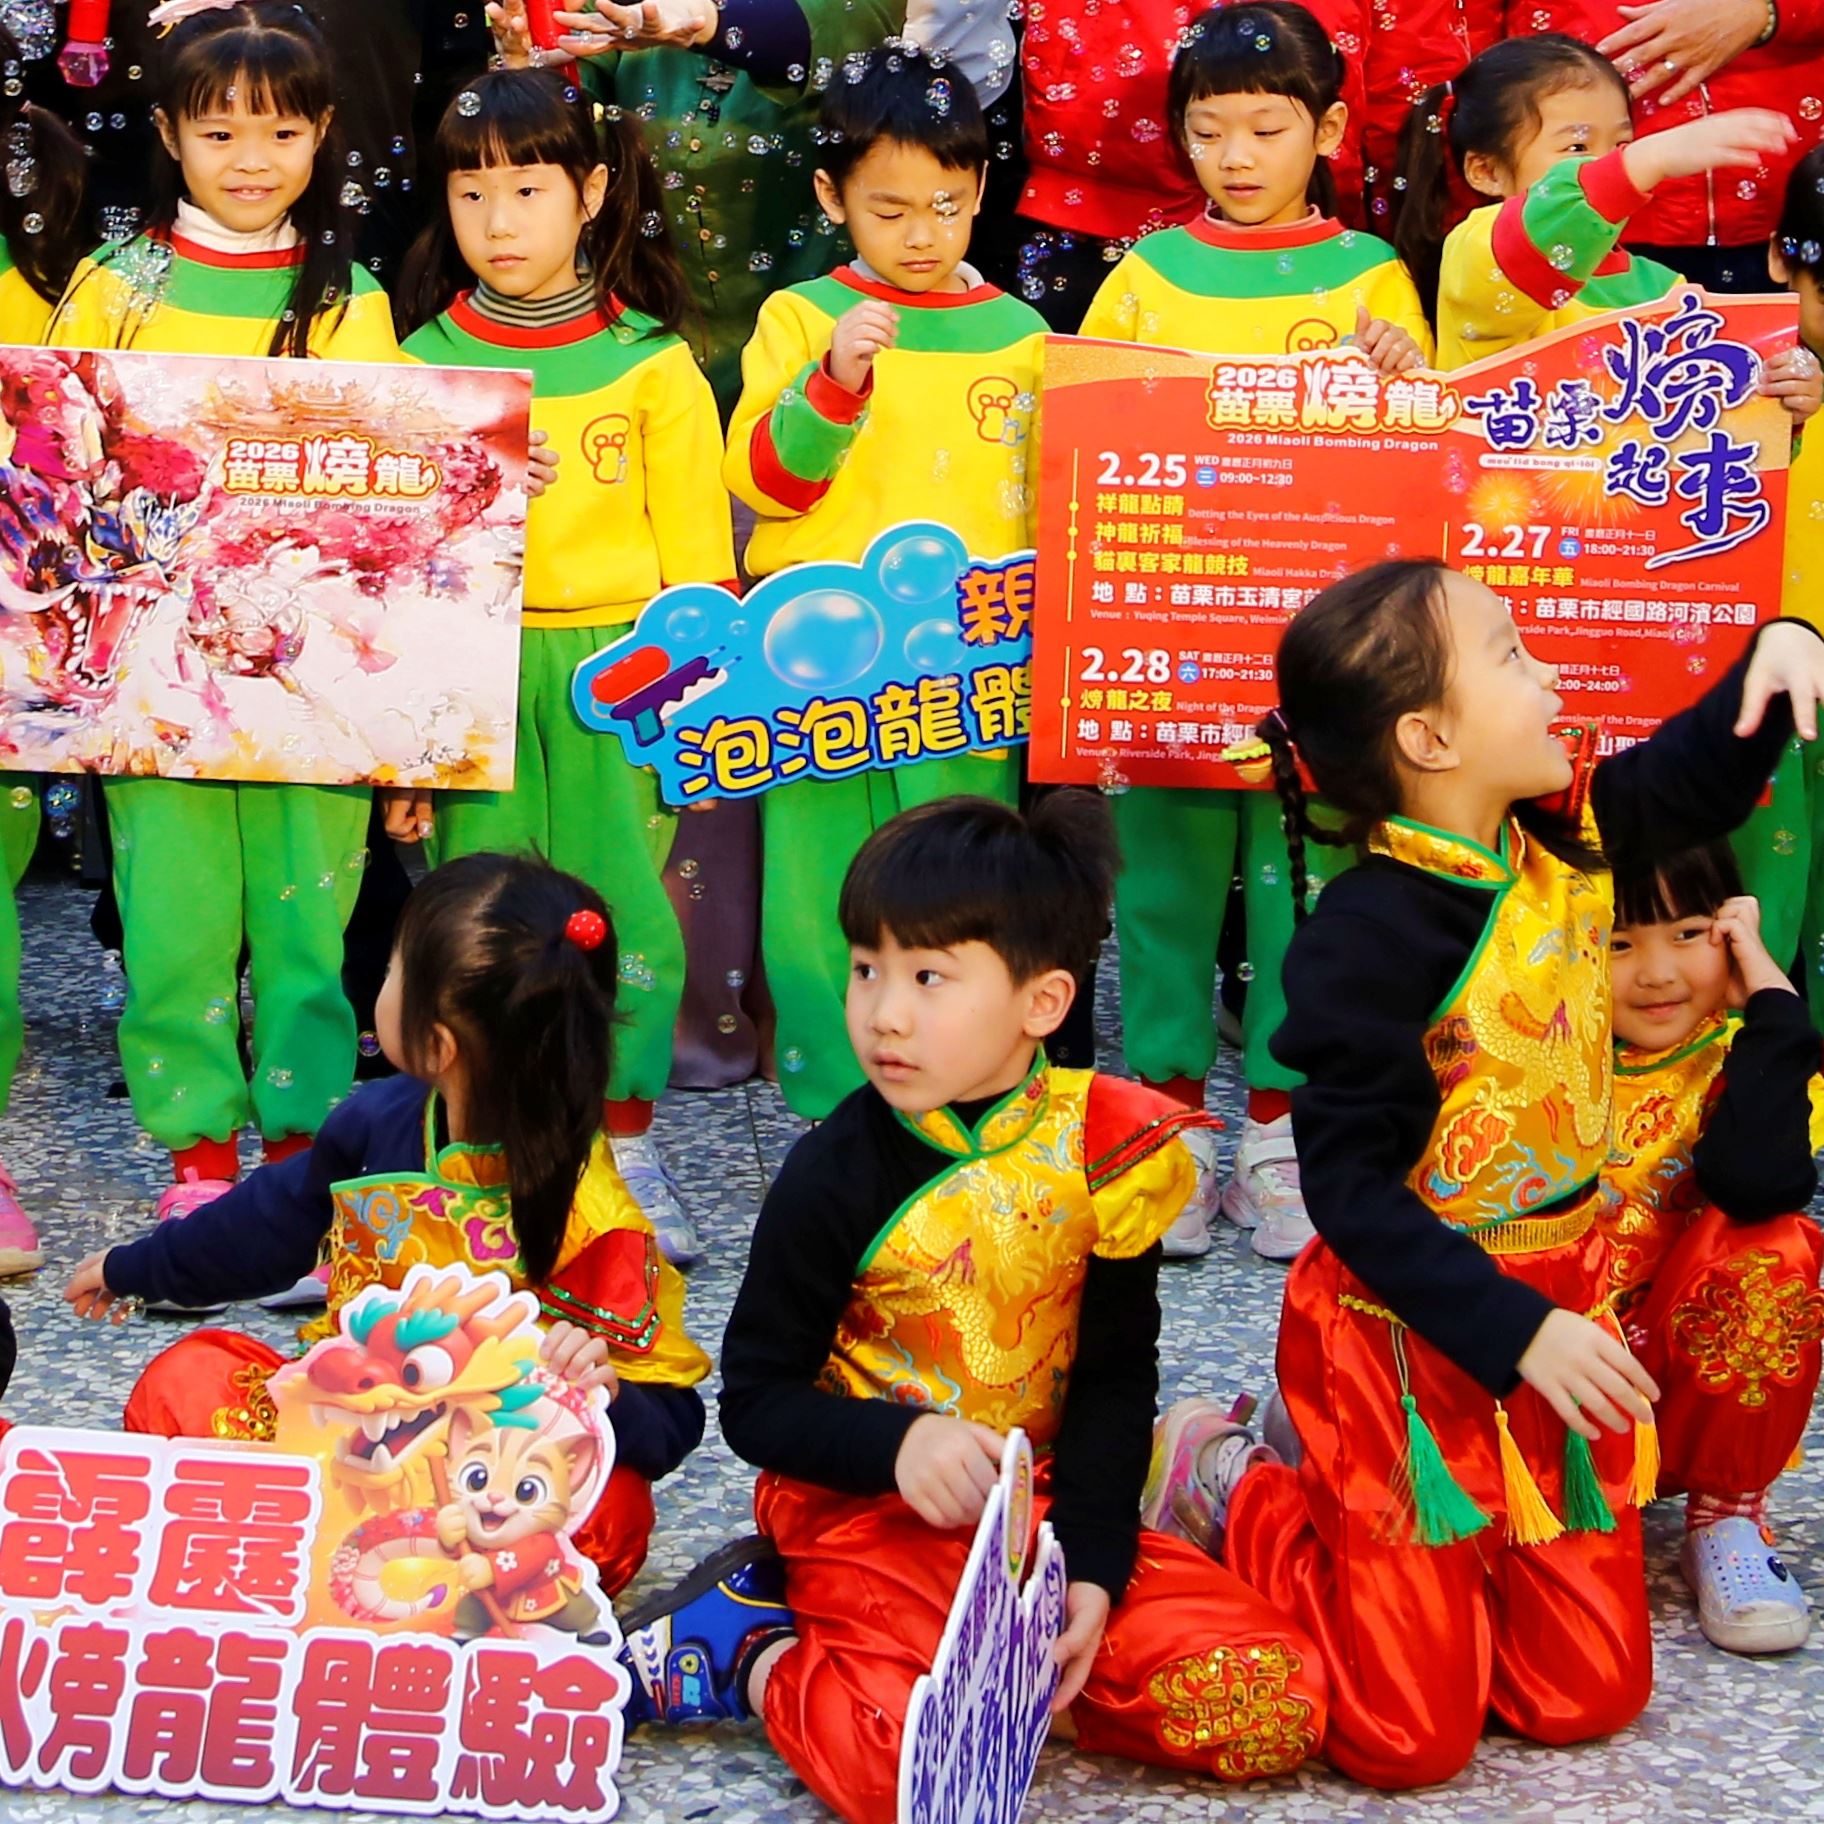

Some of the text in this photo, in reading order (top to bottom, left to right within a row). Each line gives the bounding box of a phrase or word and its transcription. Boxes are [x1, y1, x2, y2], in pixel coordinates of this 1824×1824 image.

[1216, 365, 1298, 388] 2026
[229, 440, 300, 460] 2026
[1227, 432, 1438, 453] 2026 Miaoli Bombing Dragon
[1194, 454, 1220, 466] WED
[1097, 451, 1187, 487] 2.25
[240, 496, 269, 508] 2026
[374, 502, 421, 515] Dragon
[1096, 492, 1185, 517] 祥龍點睛
[1188, 507, 1225, 522] Dotting
[1228, 509, 1244, 521] the
[1247, 510, 1270, 524] Eyes
[1272, 510, 1282, 522] of
[1283, 511, 1300, 523] the
[1359, 514, 1395, 527] Dragon
[1095, 521, 1185, 546] 神龍祈福
[1460, 522, 1552, 558] 2.27
[1560, 526, 1580, 538] FRI
[1188, 536, 1347, 554] Blessing of the Heavenly Dragon
[1583, 543, 1656, 557] 18:00~21:30
[1252, 566, 1284, 578] Miaoli
[1286, 567, 1317, 579] Hakka
[1580, 577, 1740, 593] Miaoli Bombing Dragon Carnival
[1090, 608, 1122, 620] Venue
[1170, 611, 1207, 625] Temple
[1080, 646, 1171, 683] 2.28
[1178, 650, 1200, 662] SAT
[1201, 667, 1274, 682] 17:00~21:30
[1177, 701, 1203, 714] Night
[1205, 701, 1217, 712] of
[1626, 716, 1662, 729] Dragon
[1119, 747, 1165, 760] Riverside
